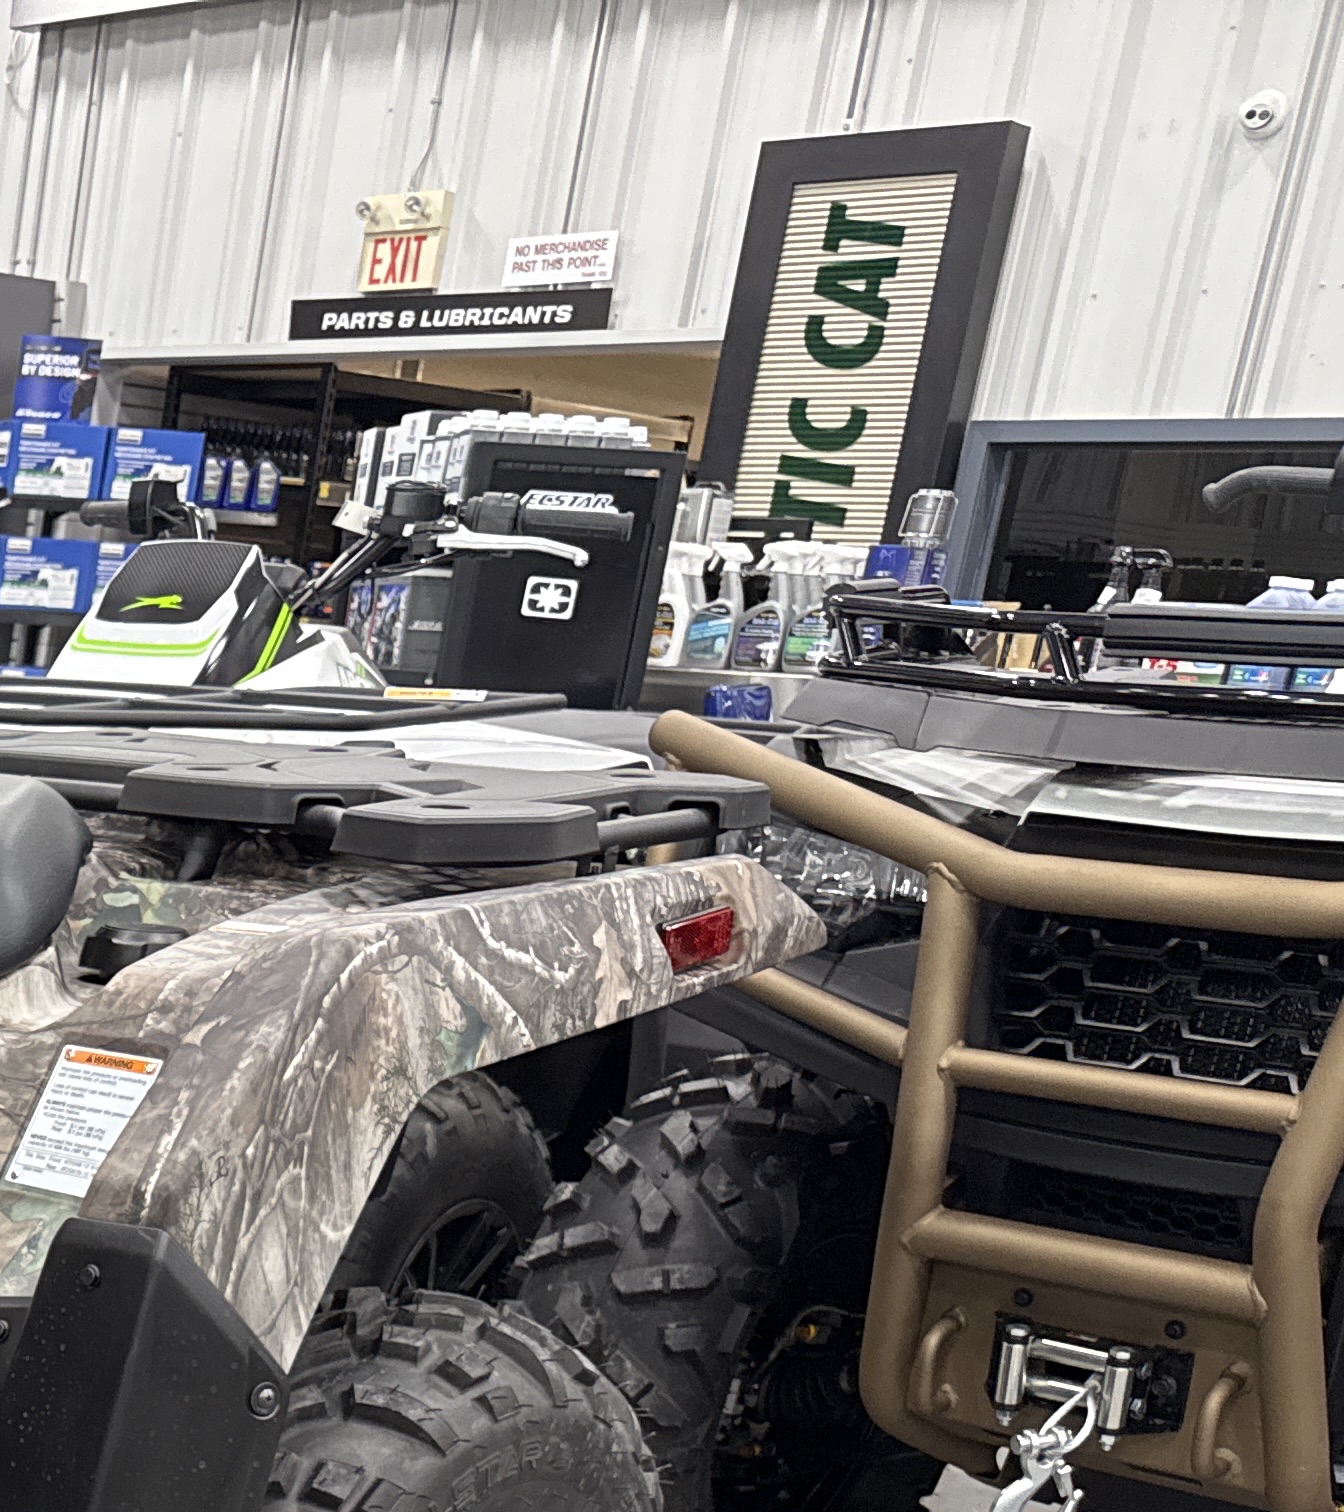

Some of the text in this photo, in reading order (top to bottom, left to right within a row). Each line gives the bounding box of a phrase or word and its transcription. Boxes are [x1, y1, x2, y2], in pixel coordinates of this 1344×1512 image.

[514, 238, 610, 258] NO MERCHANDISE
[367, 234, 428, 286] EXIT
[511, 259, 538, 274] PAST
[541, 257, 564, 271] THIS
[803, 199, 908, 370] CAT
[321, 304, 574, 331] PARTS & LUBRICANTS
[22, 352, 81, 368] SUPERIOR
[20, 364, 82, 379] BY DESIGN
[767, 396, 869, 529] TIC
[93, 1055, 135, 1071] WARNING
